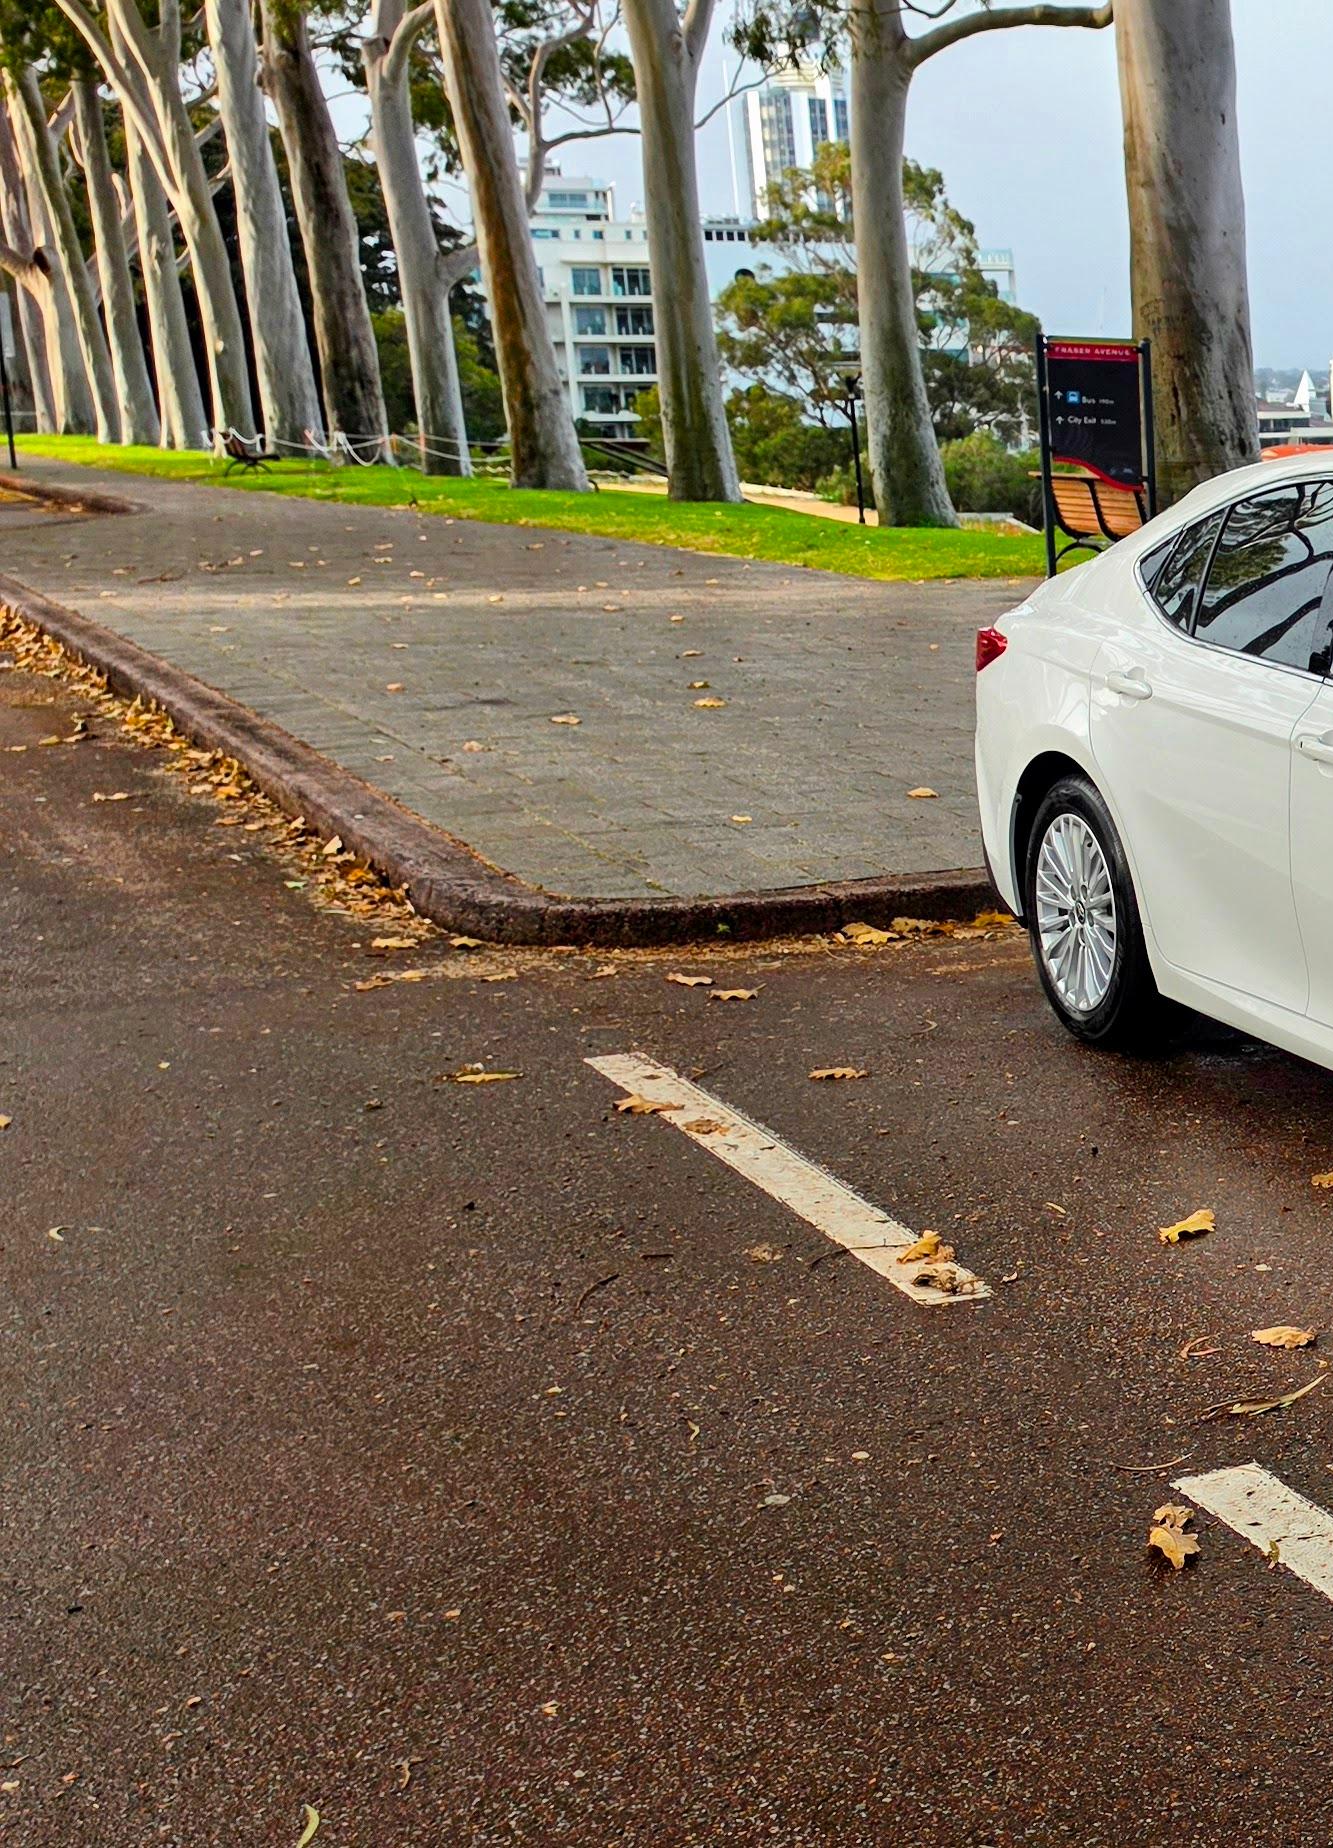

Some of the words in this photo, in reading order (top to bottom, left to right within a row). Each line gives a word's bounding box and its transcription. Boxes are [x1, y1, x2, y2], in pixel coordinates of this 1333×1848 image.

[1055, 346, 1091, 354] FRASER
[1094, 347, 1131, 356] AVENUE
[1082, 396, 1096, 404] Bus
[1067, 415, 1082, 425] City
[1083, 416, 1097, 424] Exit
